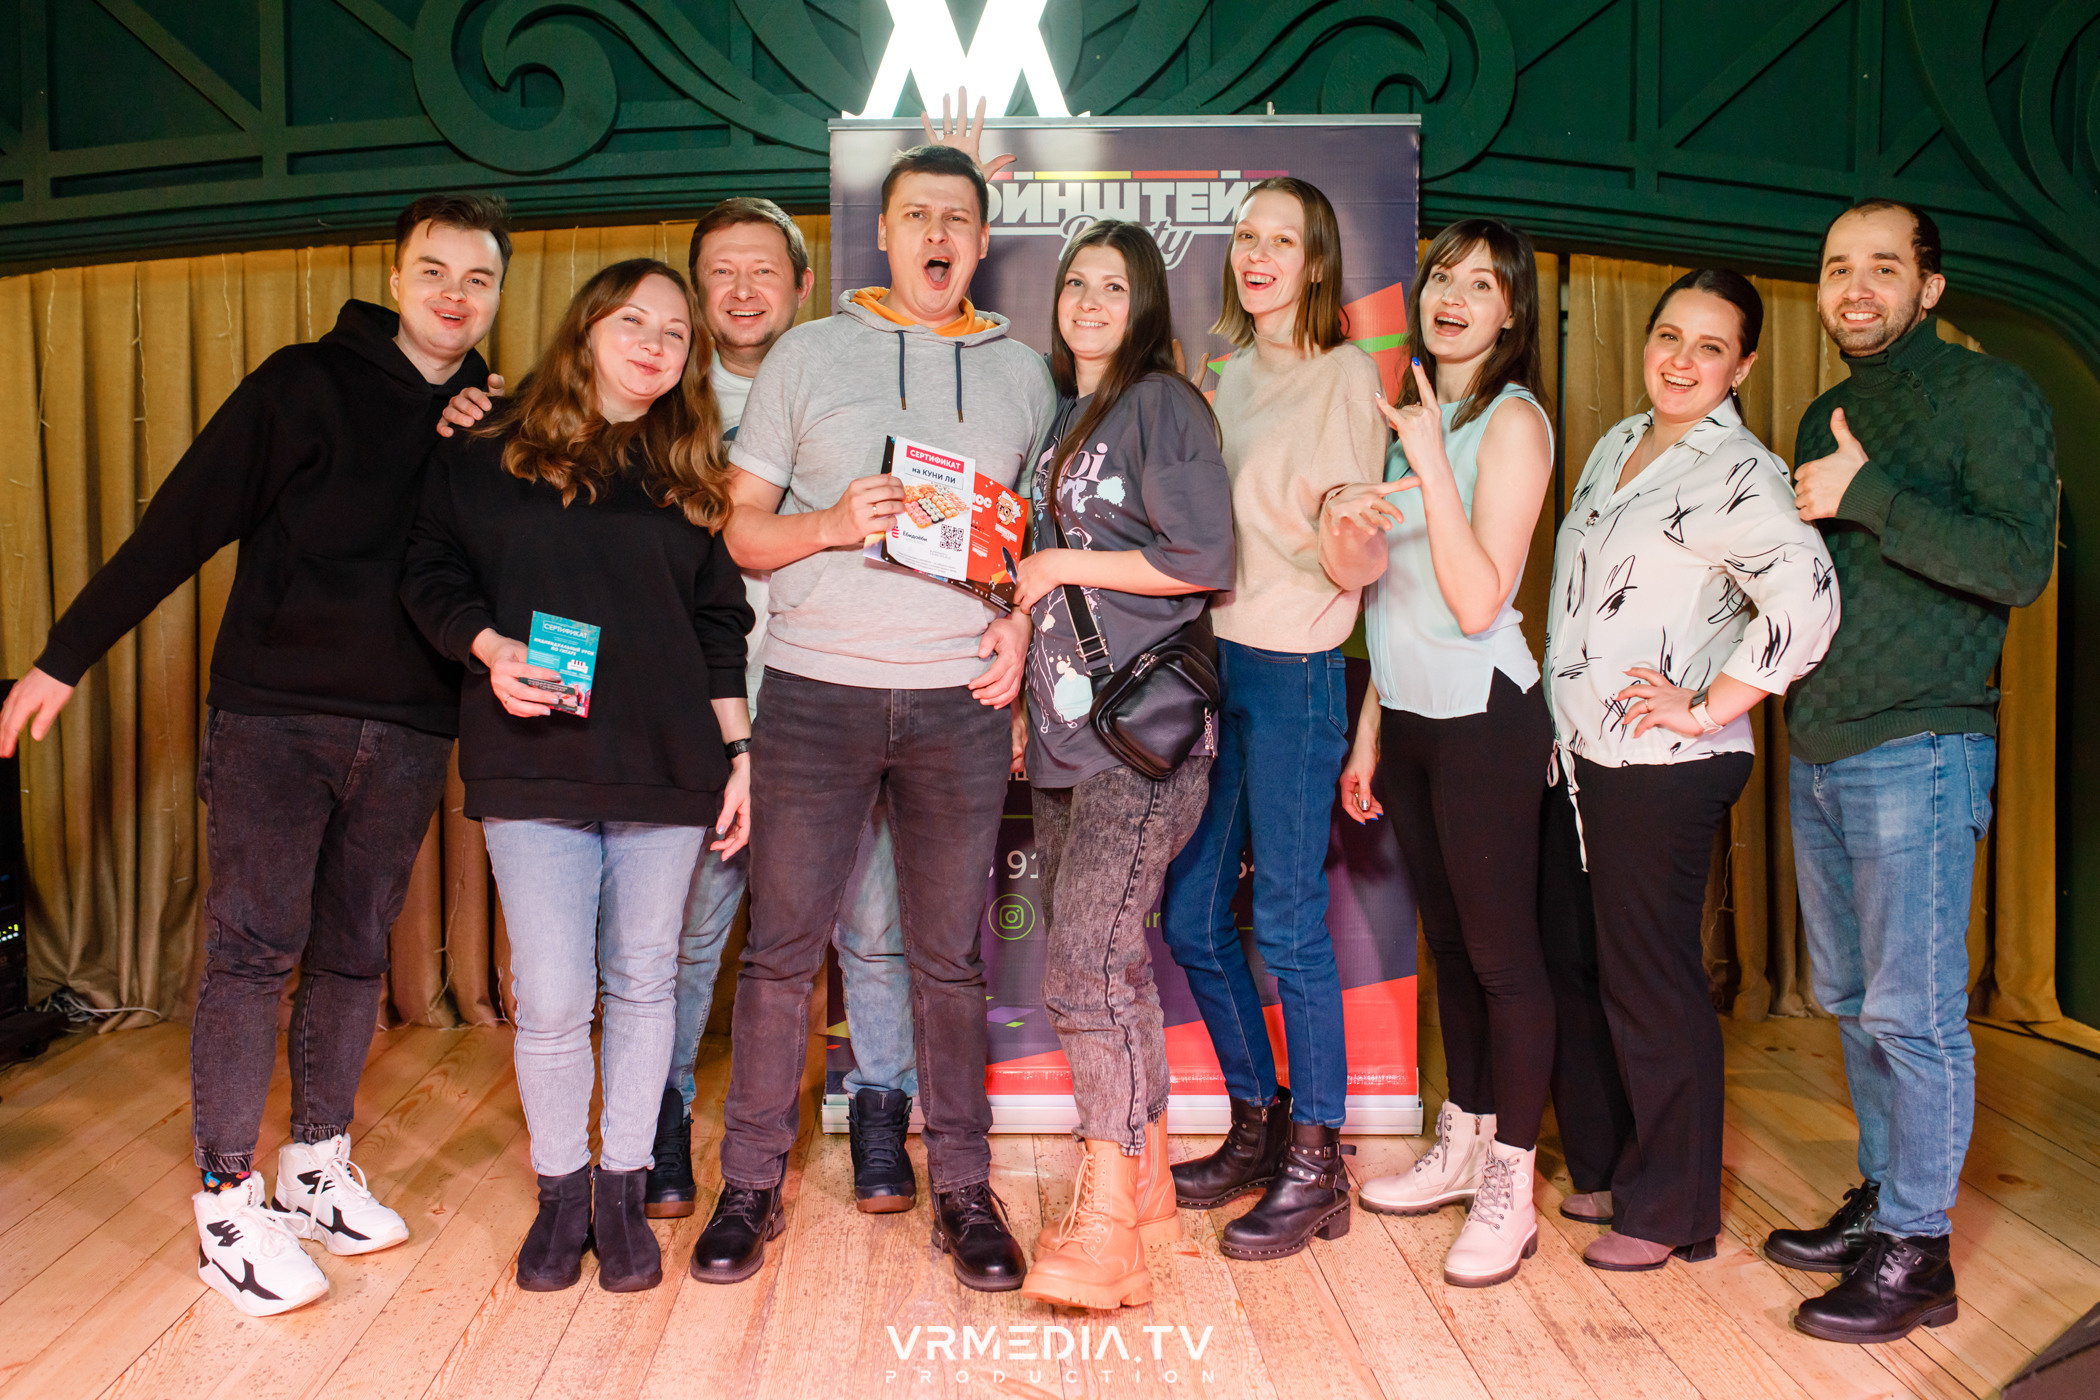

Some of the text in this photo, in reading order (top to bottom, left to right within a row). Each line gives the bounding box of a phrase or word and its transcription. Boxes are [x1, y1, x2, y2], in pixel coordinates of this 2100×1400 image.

[910, 450, 961, 470] СЕРТИФИКАТ
[912, 467, 956, 484] на КУНИ ЛИ
[543, 623, 587, 639] СЕРТИФИКАТ
